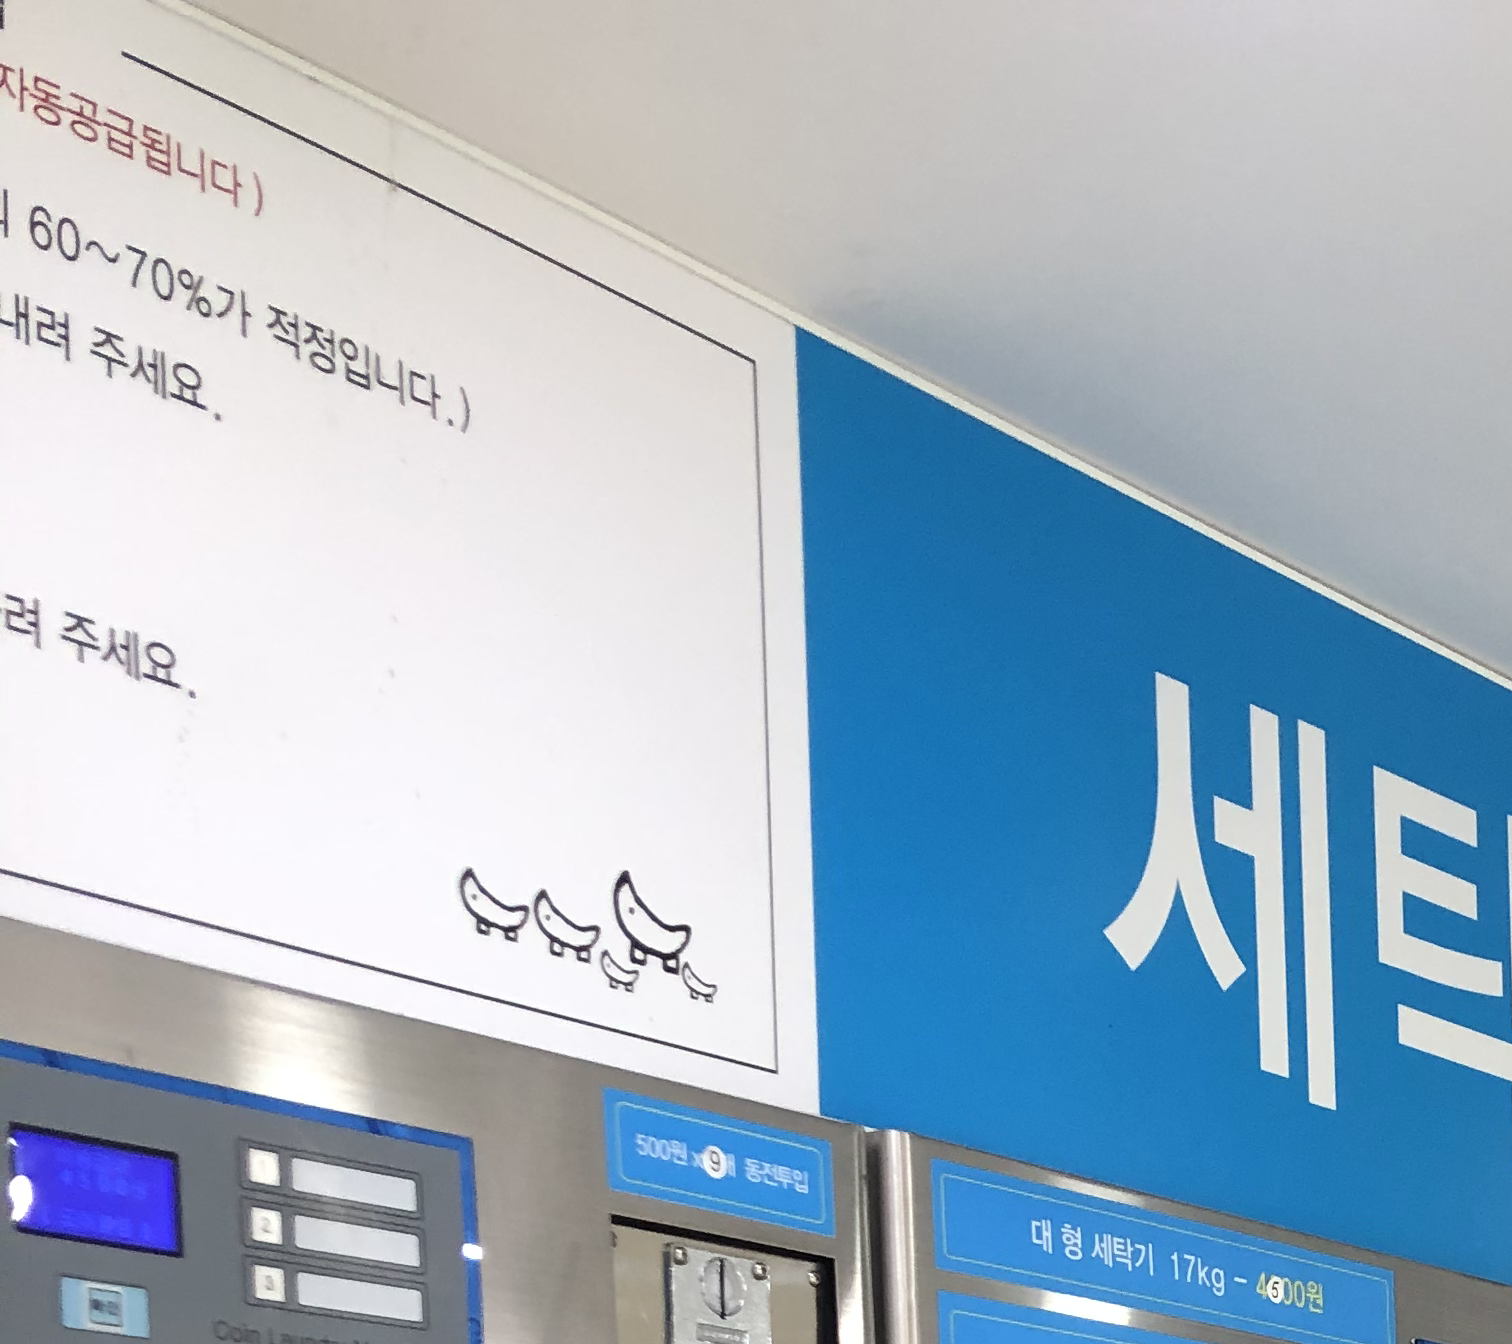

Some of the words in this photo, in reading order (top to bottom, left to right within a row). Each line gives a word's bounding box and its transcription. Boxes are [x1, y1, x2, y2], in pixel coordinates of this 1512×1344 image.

[29, 204, 251, 338] 60~70%가
[266, 304, 471, 433] 적정입니다.)
[90, 327, 223, 422] 주세요.
[0, 593, 41, 649] 려
[60, 611, 197, 699] 주세요.
[635, 1133, 688, 1166] 500원
[743, 1157, 809, 1194] 동전투입
[1091, 1232, 1155, 1277] 세탁기
[1170, 1252, 1226, 1297] 17kg
